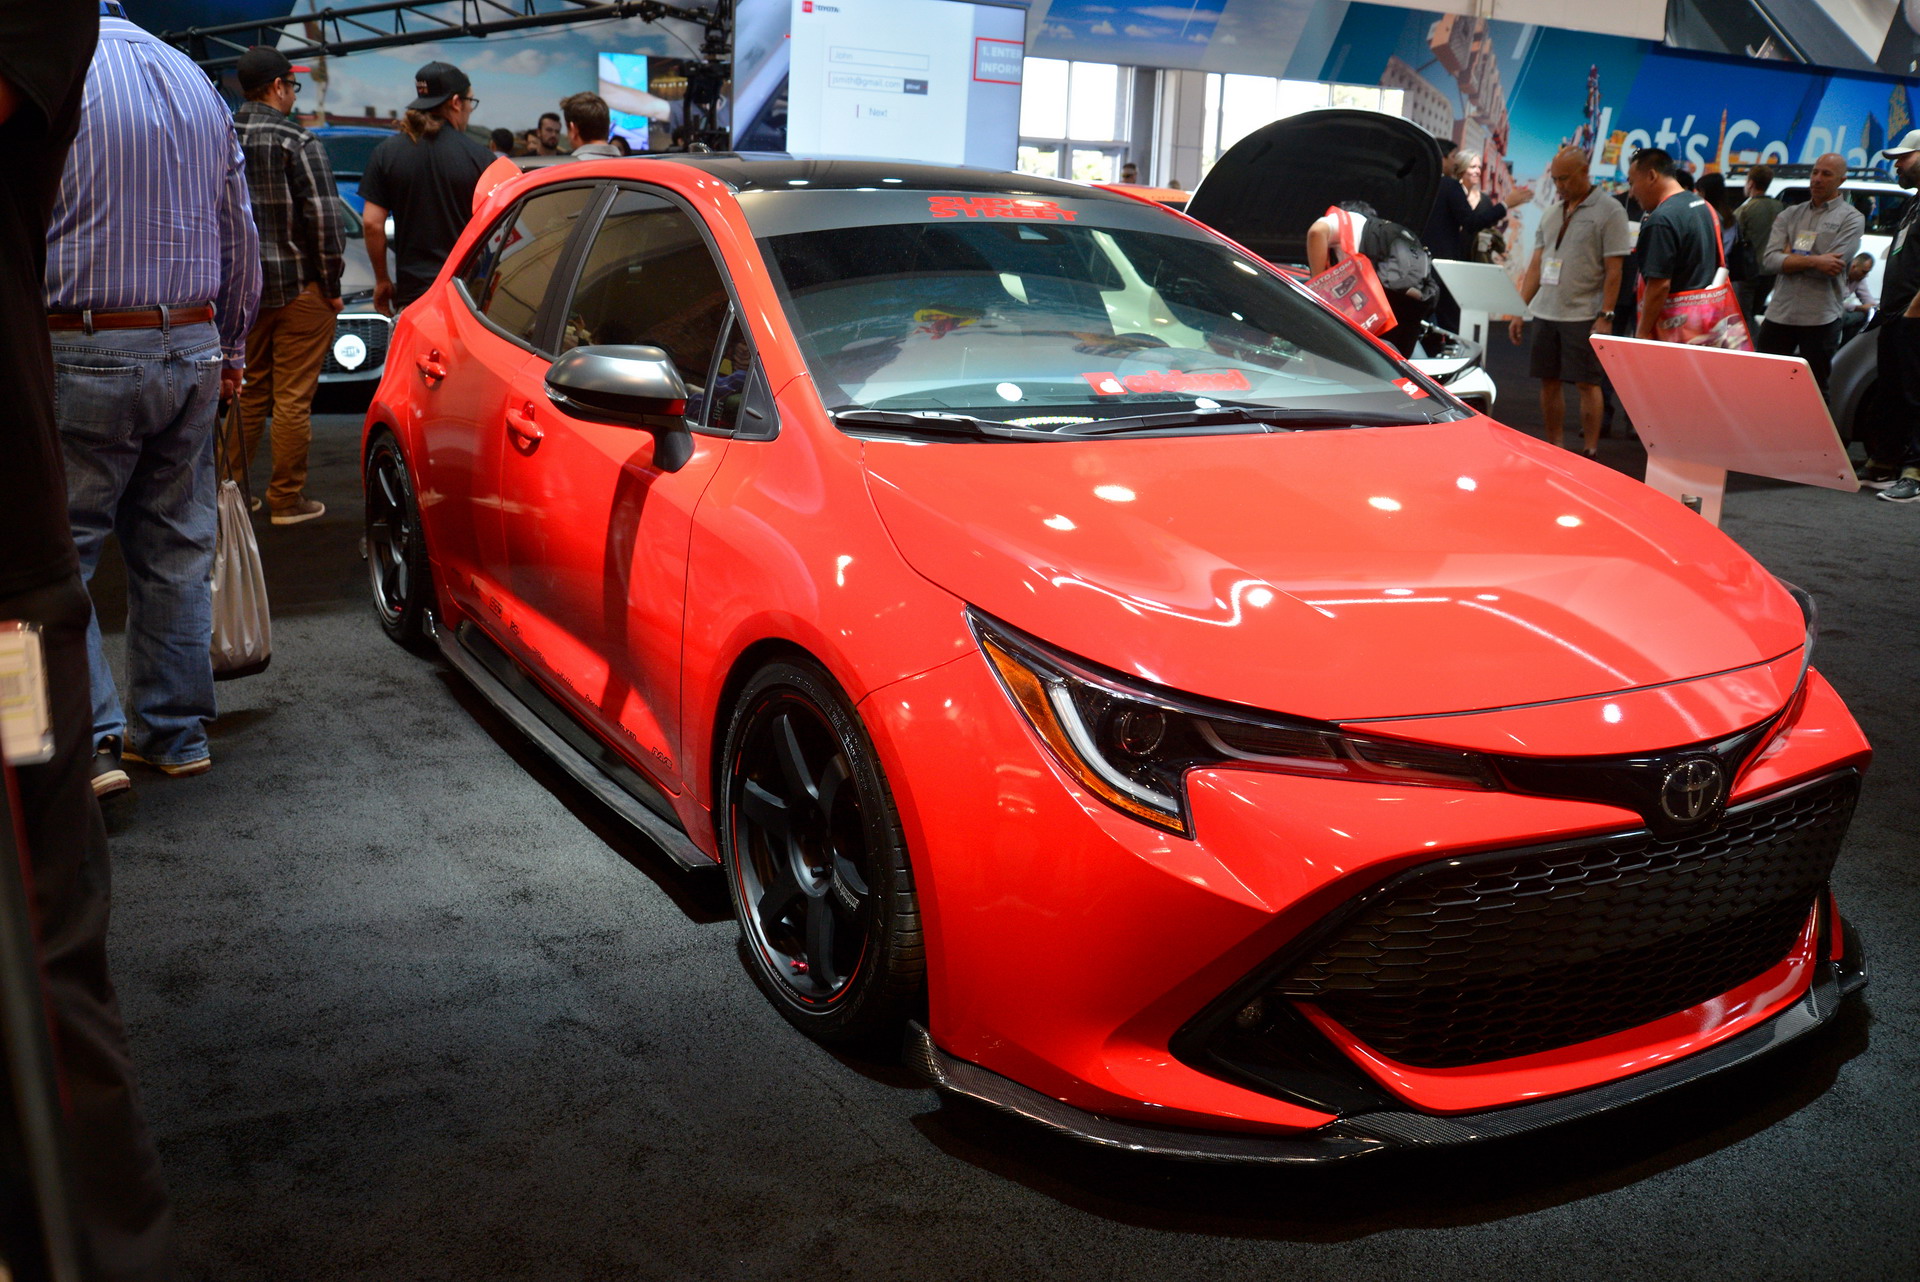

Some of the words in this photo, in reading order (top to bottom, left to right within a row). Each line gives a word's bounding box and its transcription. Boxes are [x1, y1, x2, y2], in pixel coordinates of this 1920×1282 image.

[815, 5, 839, 13] TOYOTA
[869, 107, 888, 118] Next
[1589, 97, 1709, 179] Let's
[927, 196, 1059, 209] SUPER
[929, 205, 1079, 222] STREET
